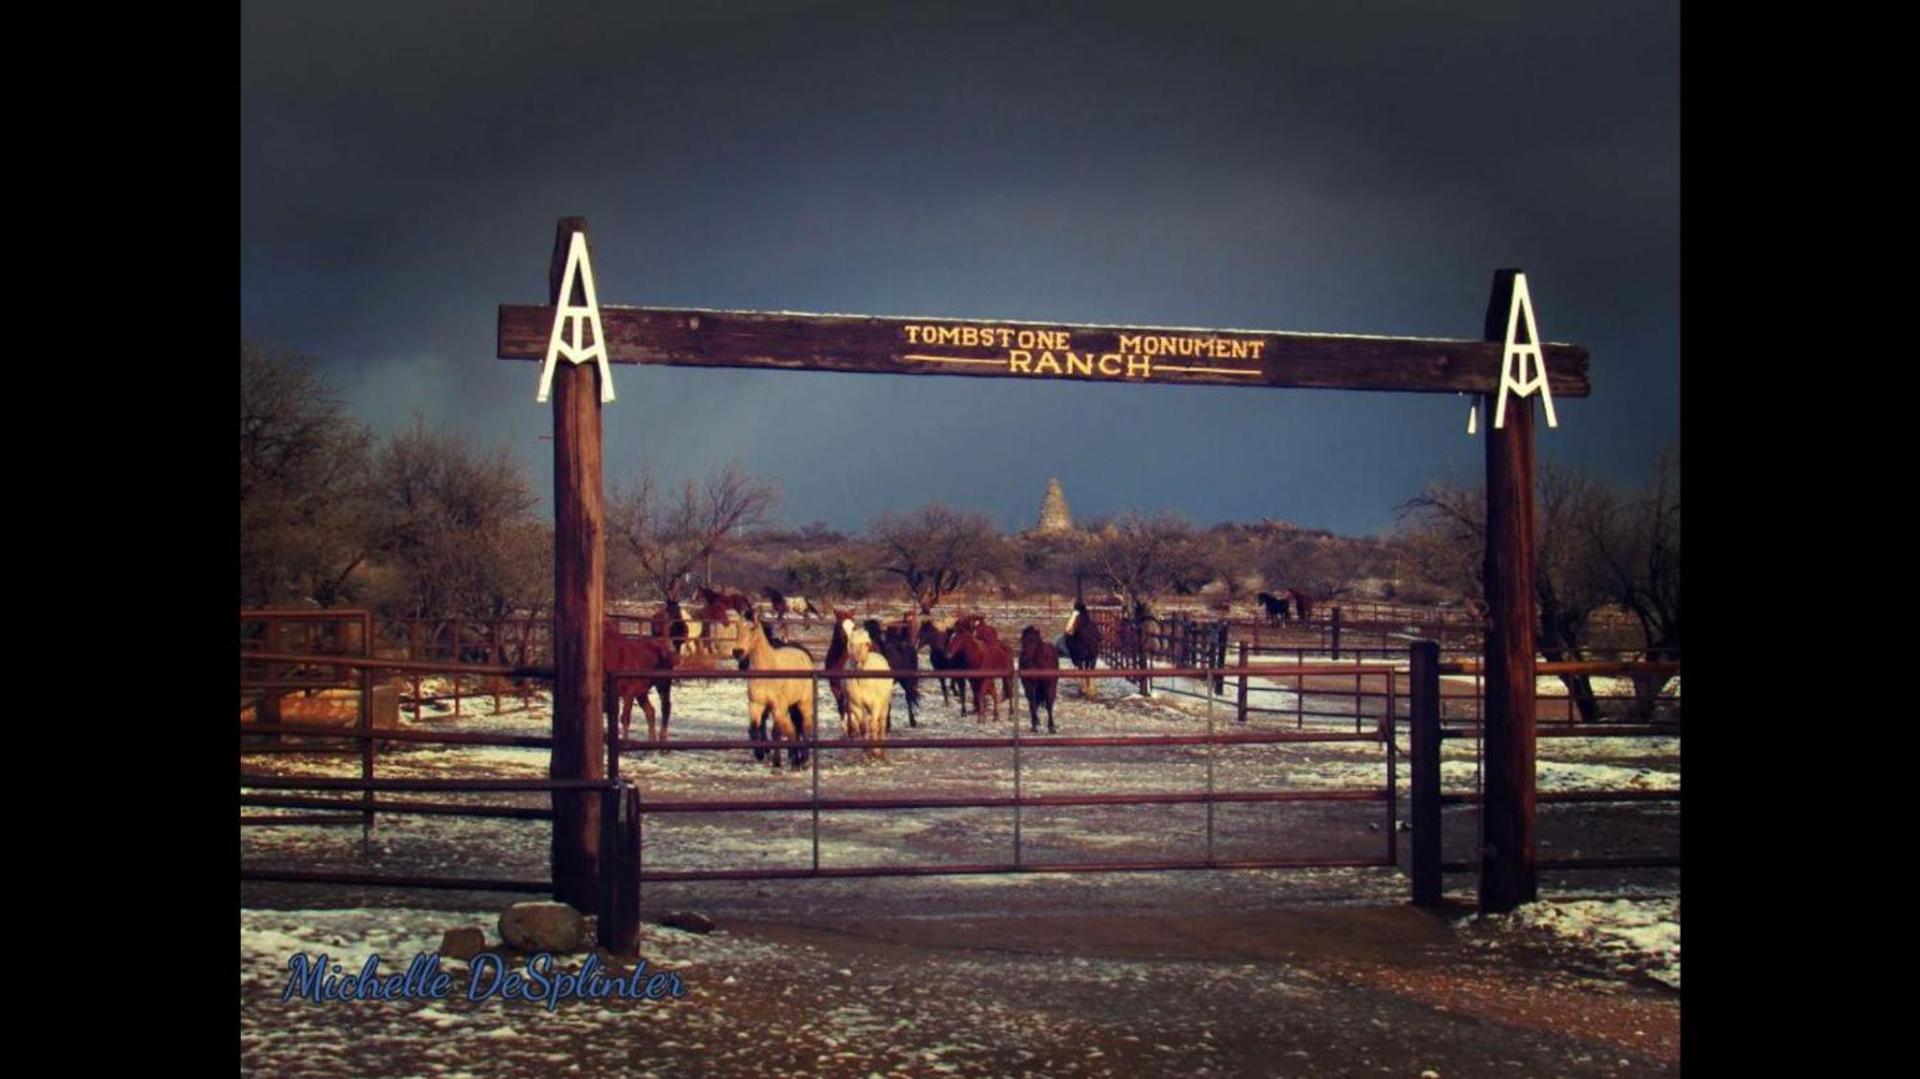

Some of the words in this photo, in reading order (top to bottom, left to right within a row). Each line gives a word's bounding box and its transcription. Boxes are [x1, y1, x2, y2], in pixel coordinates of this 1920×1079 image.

[904, 325, 1071, 350] TOMBSTONE
[1119, 334, 1265, 359] MONUMENT
[1008, 349, 1152, 377] RANCH
